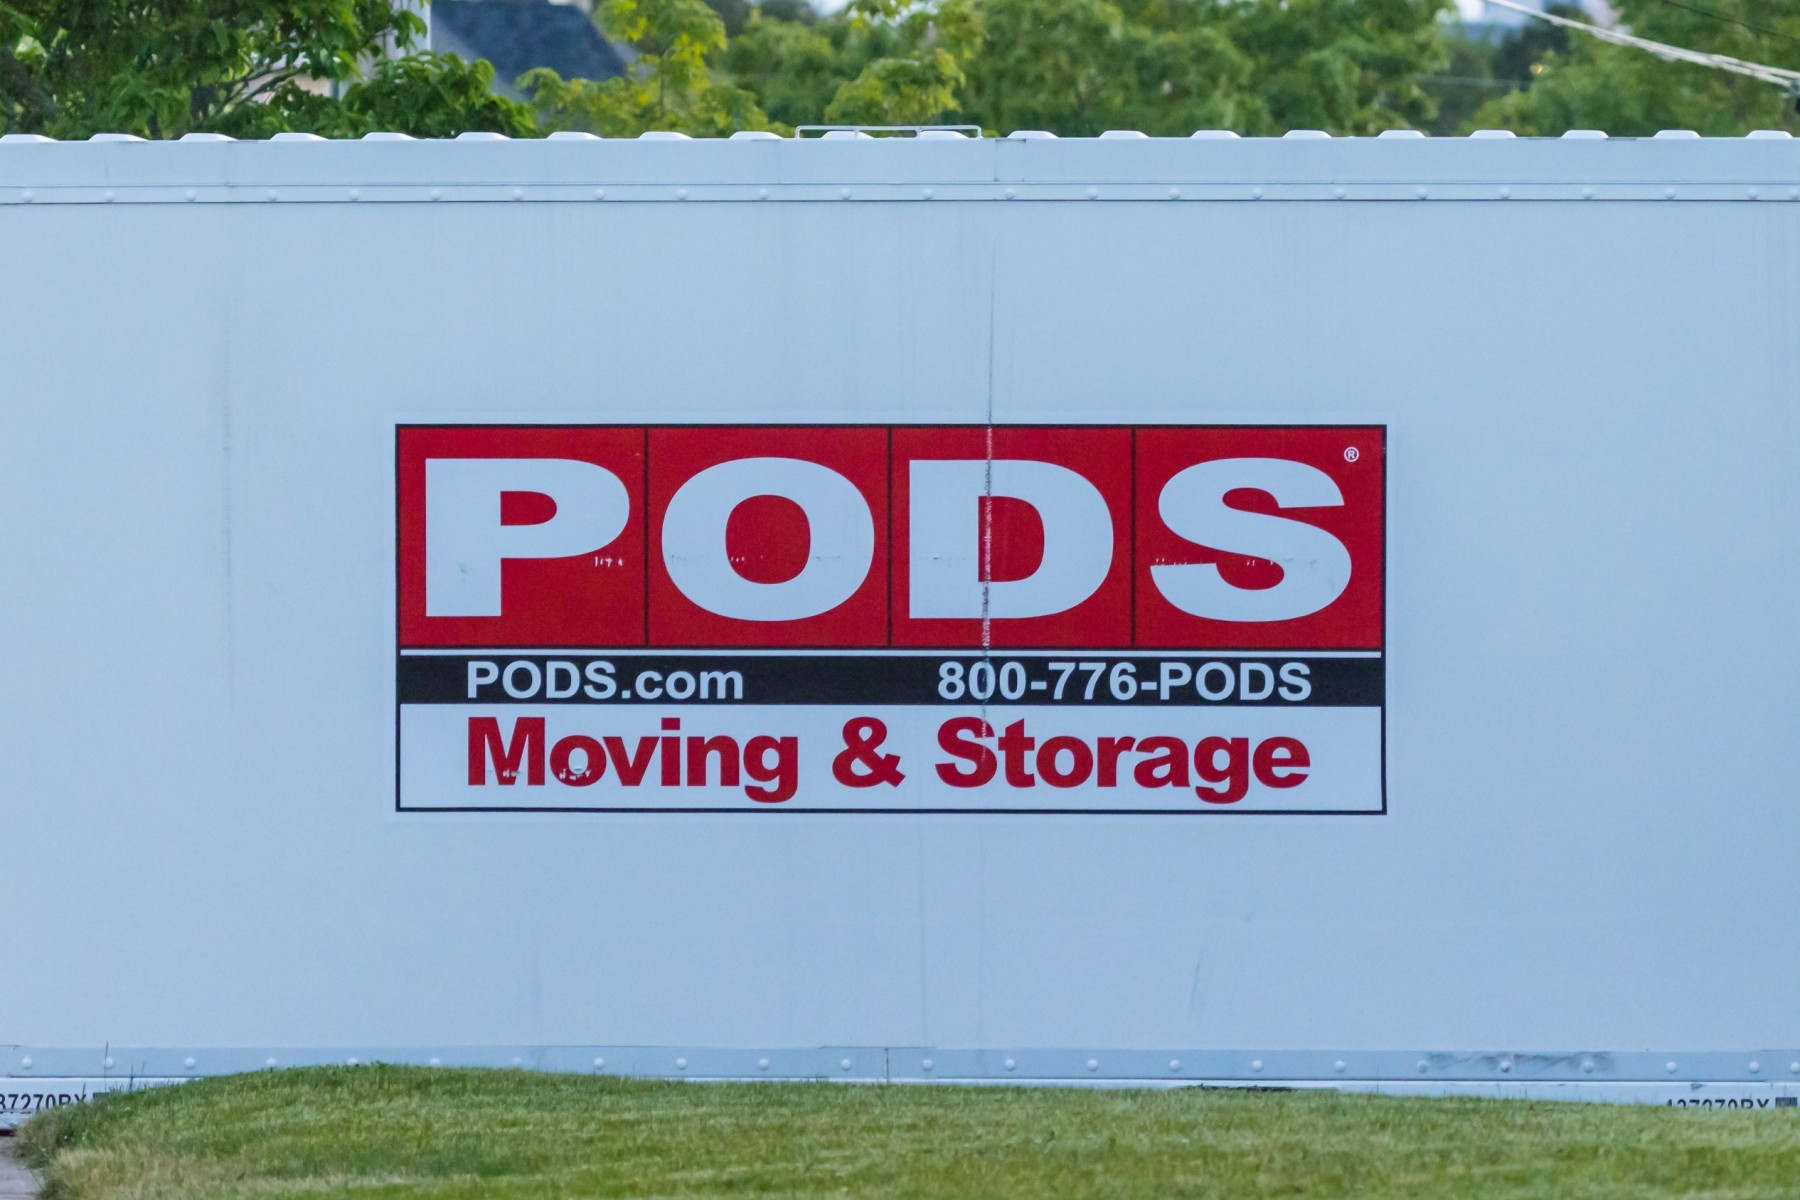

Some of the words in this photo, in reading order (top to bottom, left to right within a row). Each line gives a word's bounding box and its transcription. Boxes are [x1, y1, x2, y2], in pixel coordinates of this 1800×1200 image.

[467, 660, 744, 700] PODS.com
[937, 661, 1312, 701] 800-776-PODS
[468, 717, 798, 803] Moving
[832, 716, 906, 788] &
[935, 716, 1311, 804] Storage
